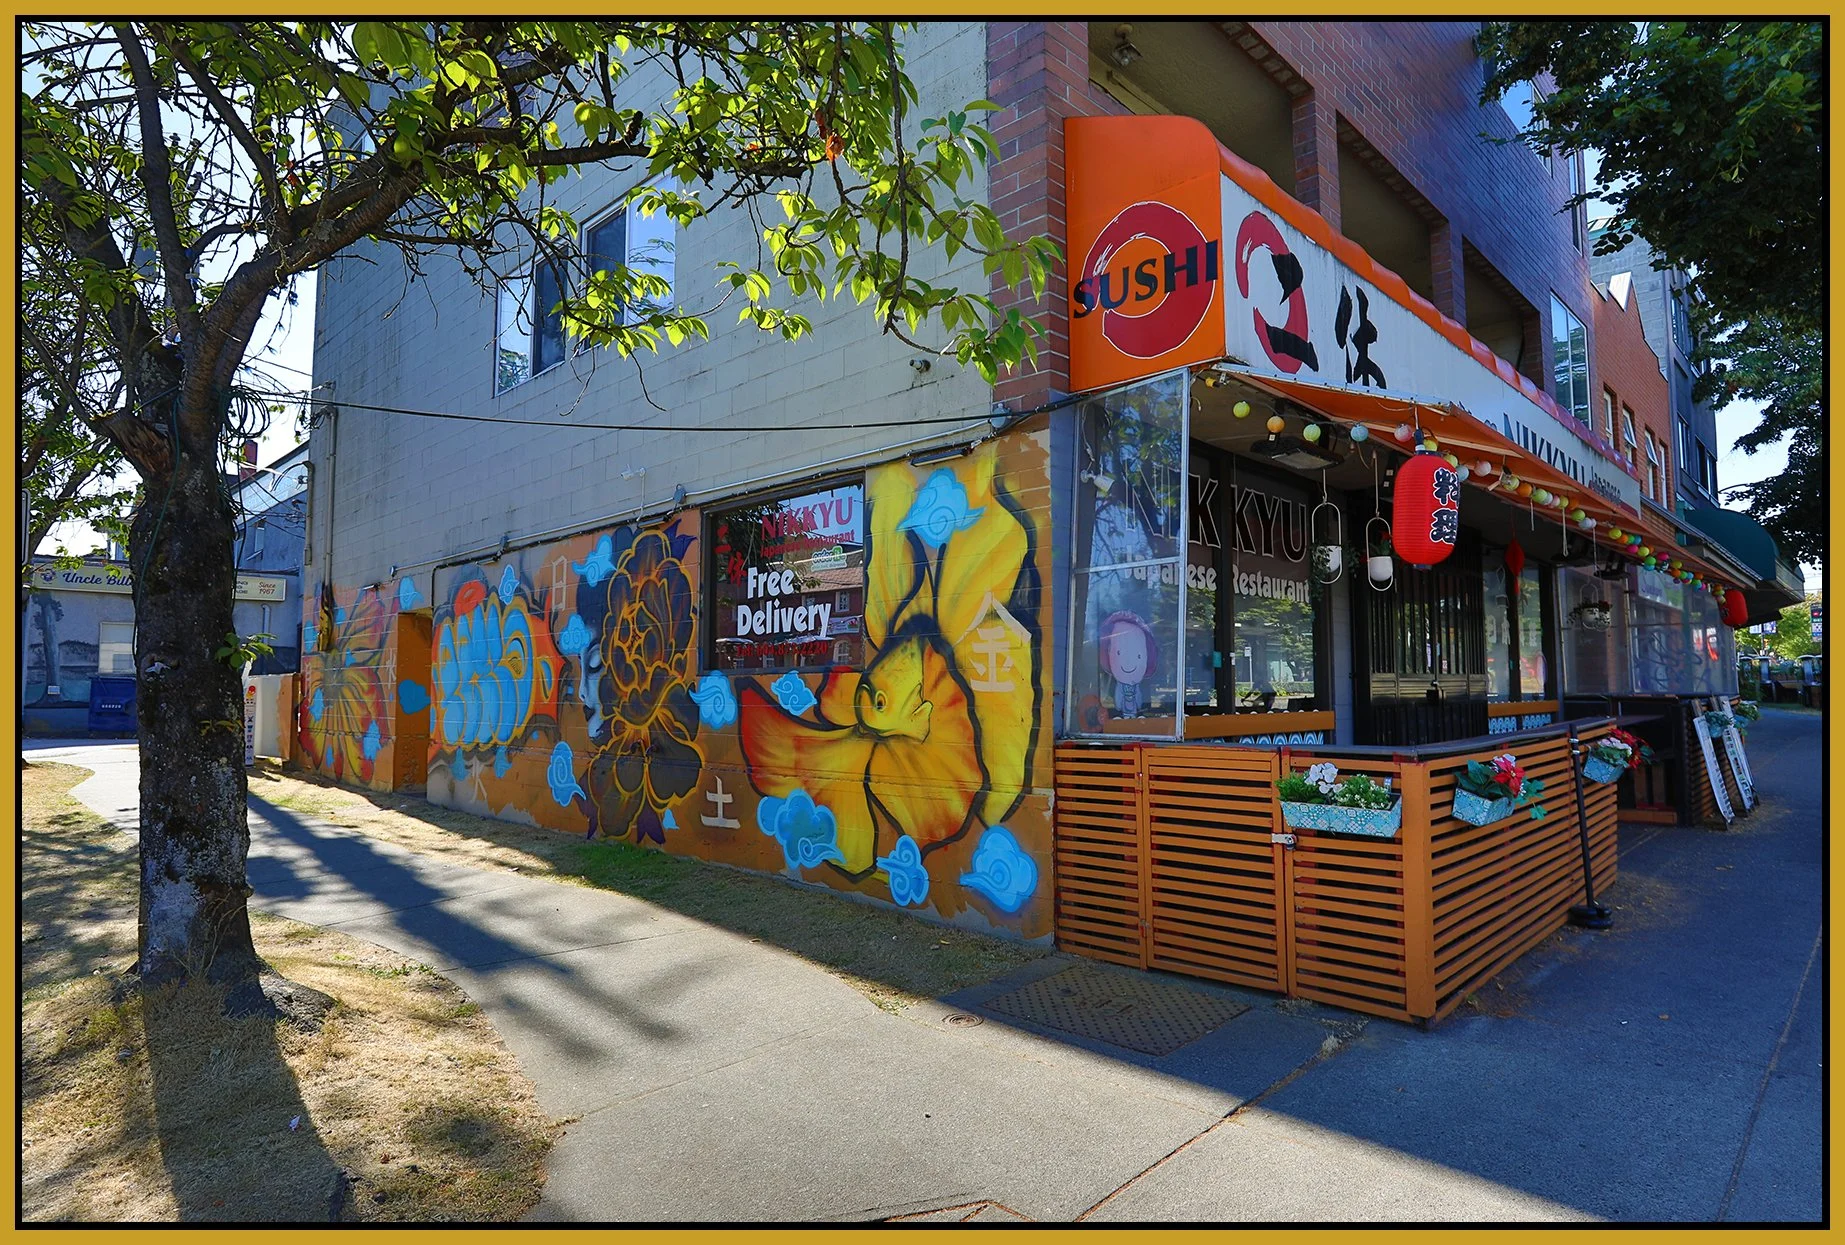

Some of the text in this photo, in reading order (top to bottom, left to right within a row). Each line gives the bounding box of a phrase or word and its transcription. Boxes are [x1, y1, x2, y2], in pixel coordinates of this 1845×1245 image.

[1073, 239, 1219, 319] SUSHI
[761, 496, 853, 541] NIKKYU
[62, 572, 102, 585] Uncle
[747, 566, 795, 600] Free
[737, 598, 832, 638] Delivery
[953, 591, 1032, 692] 金
[700, 775, 741, 830] 土
